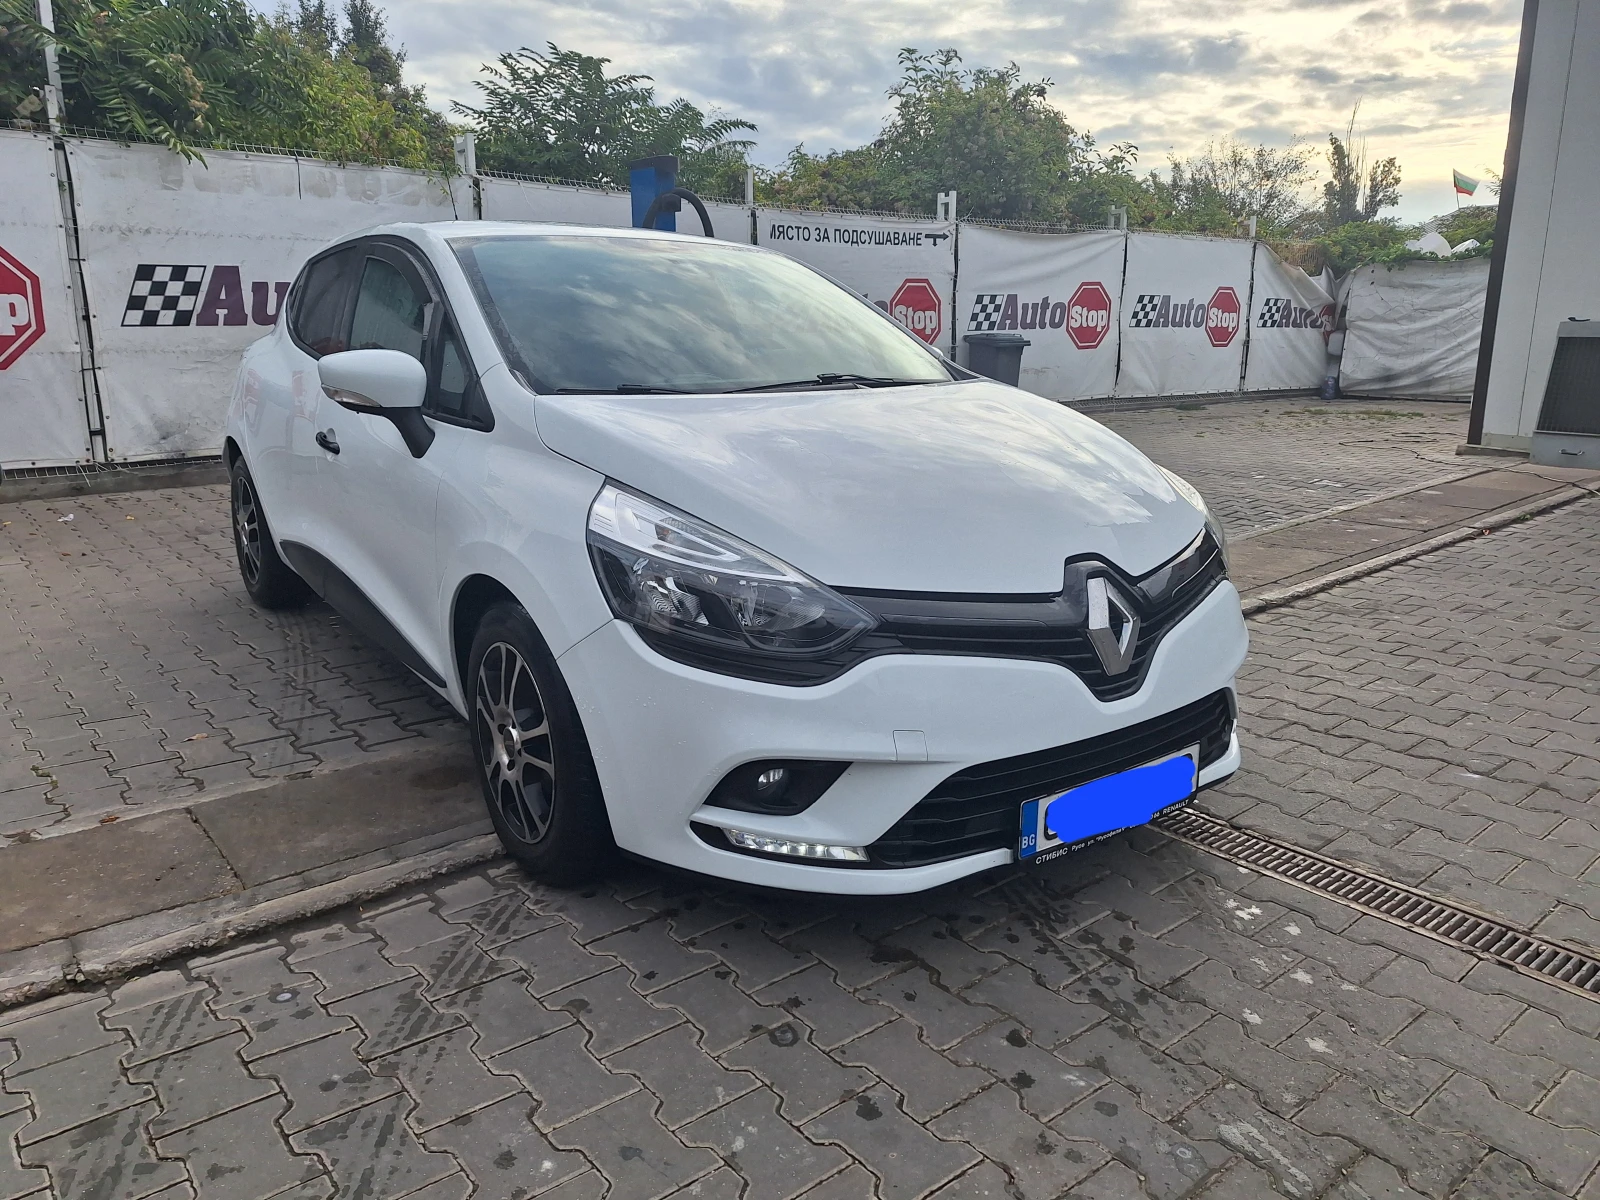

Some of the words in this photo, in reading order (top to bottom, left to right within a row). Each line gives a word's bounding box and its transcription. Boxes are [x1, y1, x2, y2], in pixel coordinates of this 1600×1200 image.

[814, 227, 831, 242] ЗА
[834, 228, 923, 247] ПОДСУШАВАНЕ
[195, 265, 292, 327] Au
[996, 294, 1067, 331] Auto
[1070, 305, 1107, 332] Stop
[1152, 295, 1207, 328] Auto
[1208, 307, 1238, 332] Stop
[894, 304, 937, 335] Stop
[1021, 833, 1036, 849] BG
[1035, 847, 1069, 865] СТИБИС
[1162, 799, 1190, 815] RENAULT
